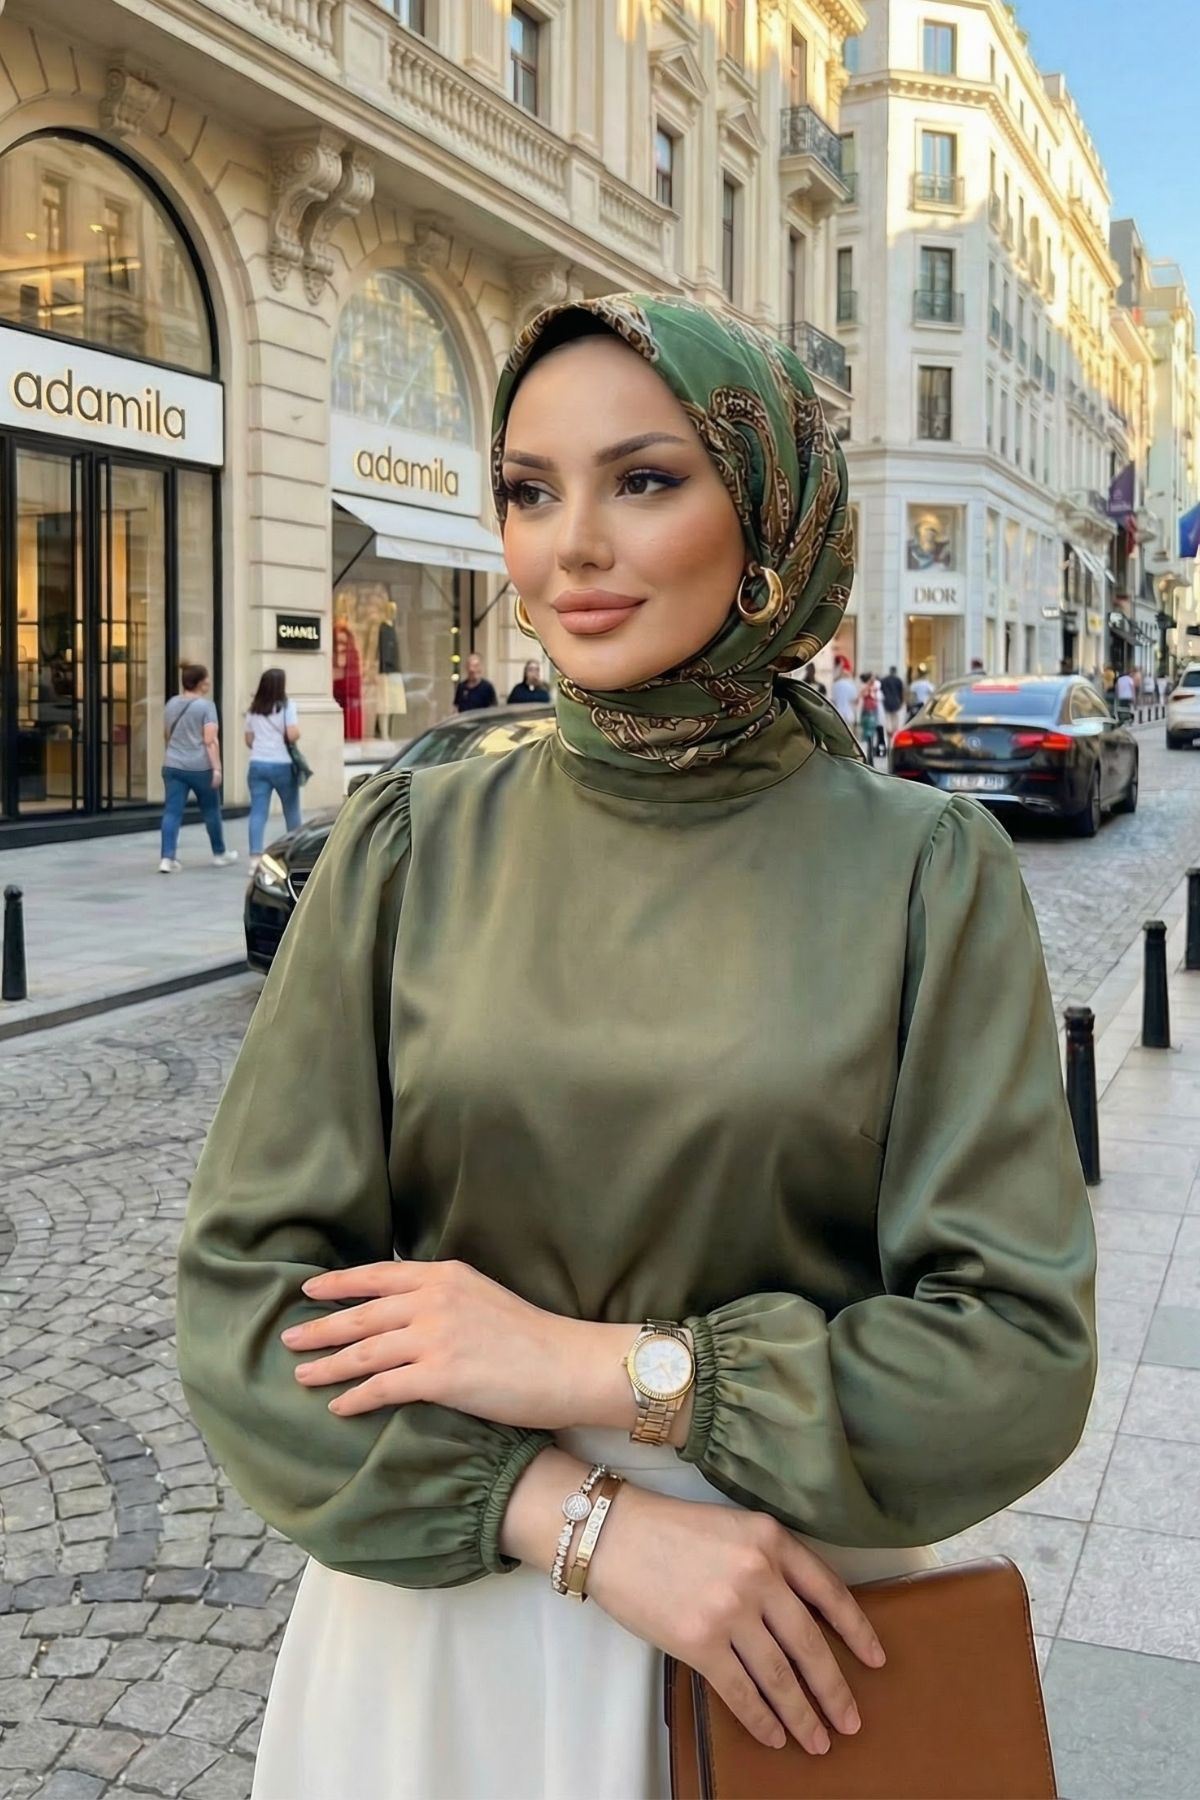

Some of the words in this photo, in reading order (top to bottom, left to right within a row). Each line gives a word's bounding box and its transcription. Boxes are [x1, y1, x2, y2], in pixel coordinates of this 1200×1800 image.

[14, 368, 186, 440] adamila
[357, 445, 459, 497] adamila
[914, 586, 958, 604] DIOR
[279, 624, 319, 640] CHANEL
